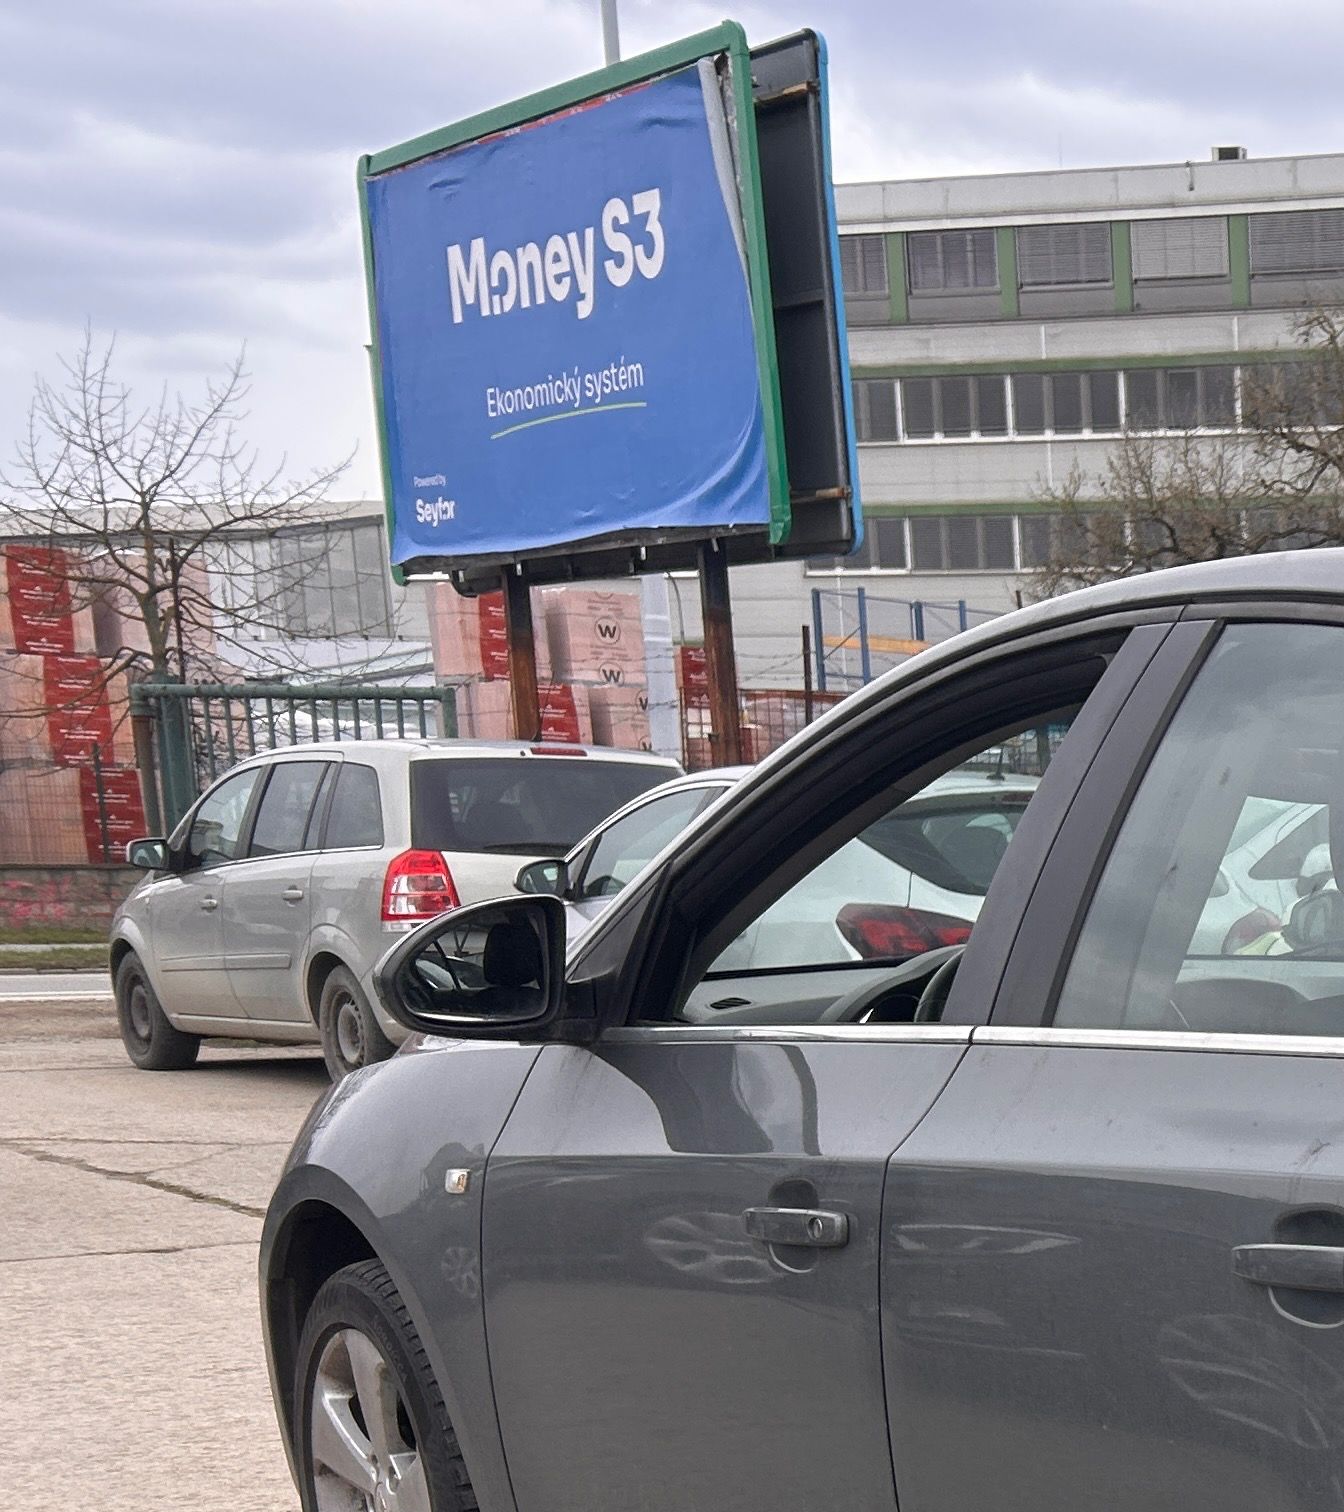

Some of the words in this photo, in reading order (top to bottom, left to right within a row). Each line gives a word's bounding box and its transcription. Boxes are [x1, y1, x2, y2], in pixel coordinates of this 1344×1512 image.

[447, 226, 595, 324] Money
[601, 188, 665, 287] S3
[486, 365, 581, 417] Ekonomický
[584, 355, 645, 404] systém
[597, 624, 616, 639] W
[602, 669, 621, 683] W
